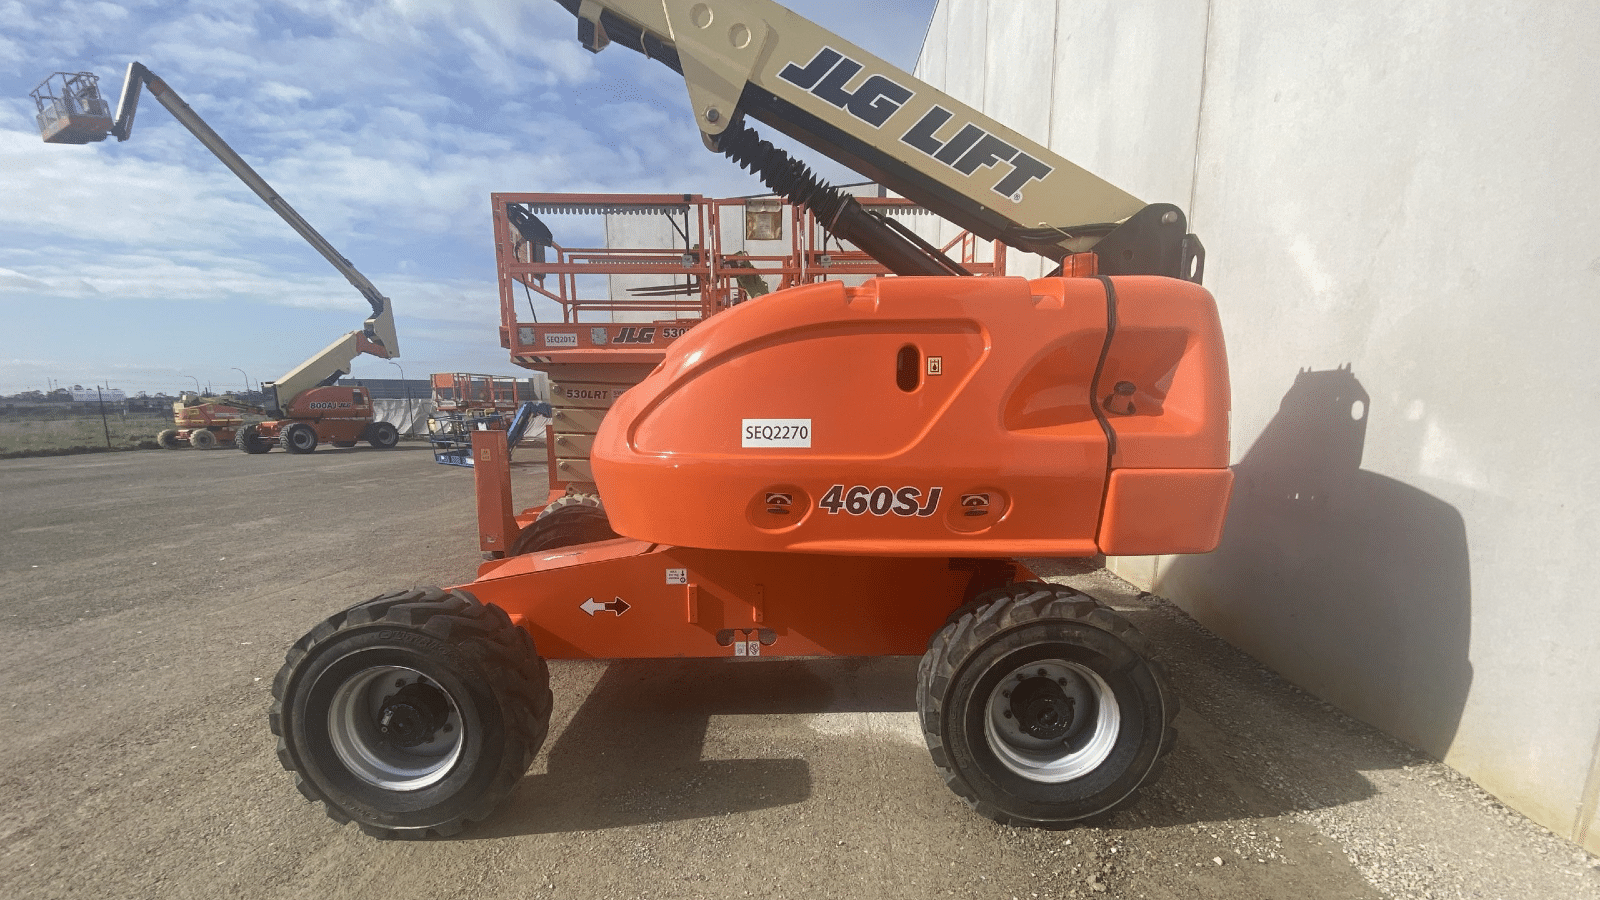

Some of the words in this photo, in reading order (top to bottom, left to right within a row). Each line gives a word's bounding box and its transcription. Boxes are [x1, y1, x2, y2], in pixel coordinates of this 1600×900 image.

[776, 45, 916, 130] JLG
[899, 104, 1055, 200] LIFT
[546, 335, 576, 343] SEQ2012
[612, 327, 656, 344] JLG
[663, 327, 689, 339] 530
[566, 389, 608, 399] 530LRT
[310, 401, 337, 410] 800AJ
[745, 425, 808, 441] SEQ2270
[818, 484, 942, 517] 460SJ
